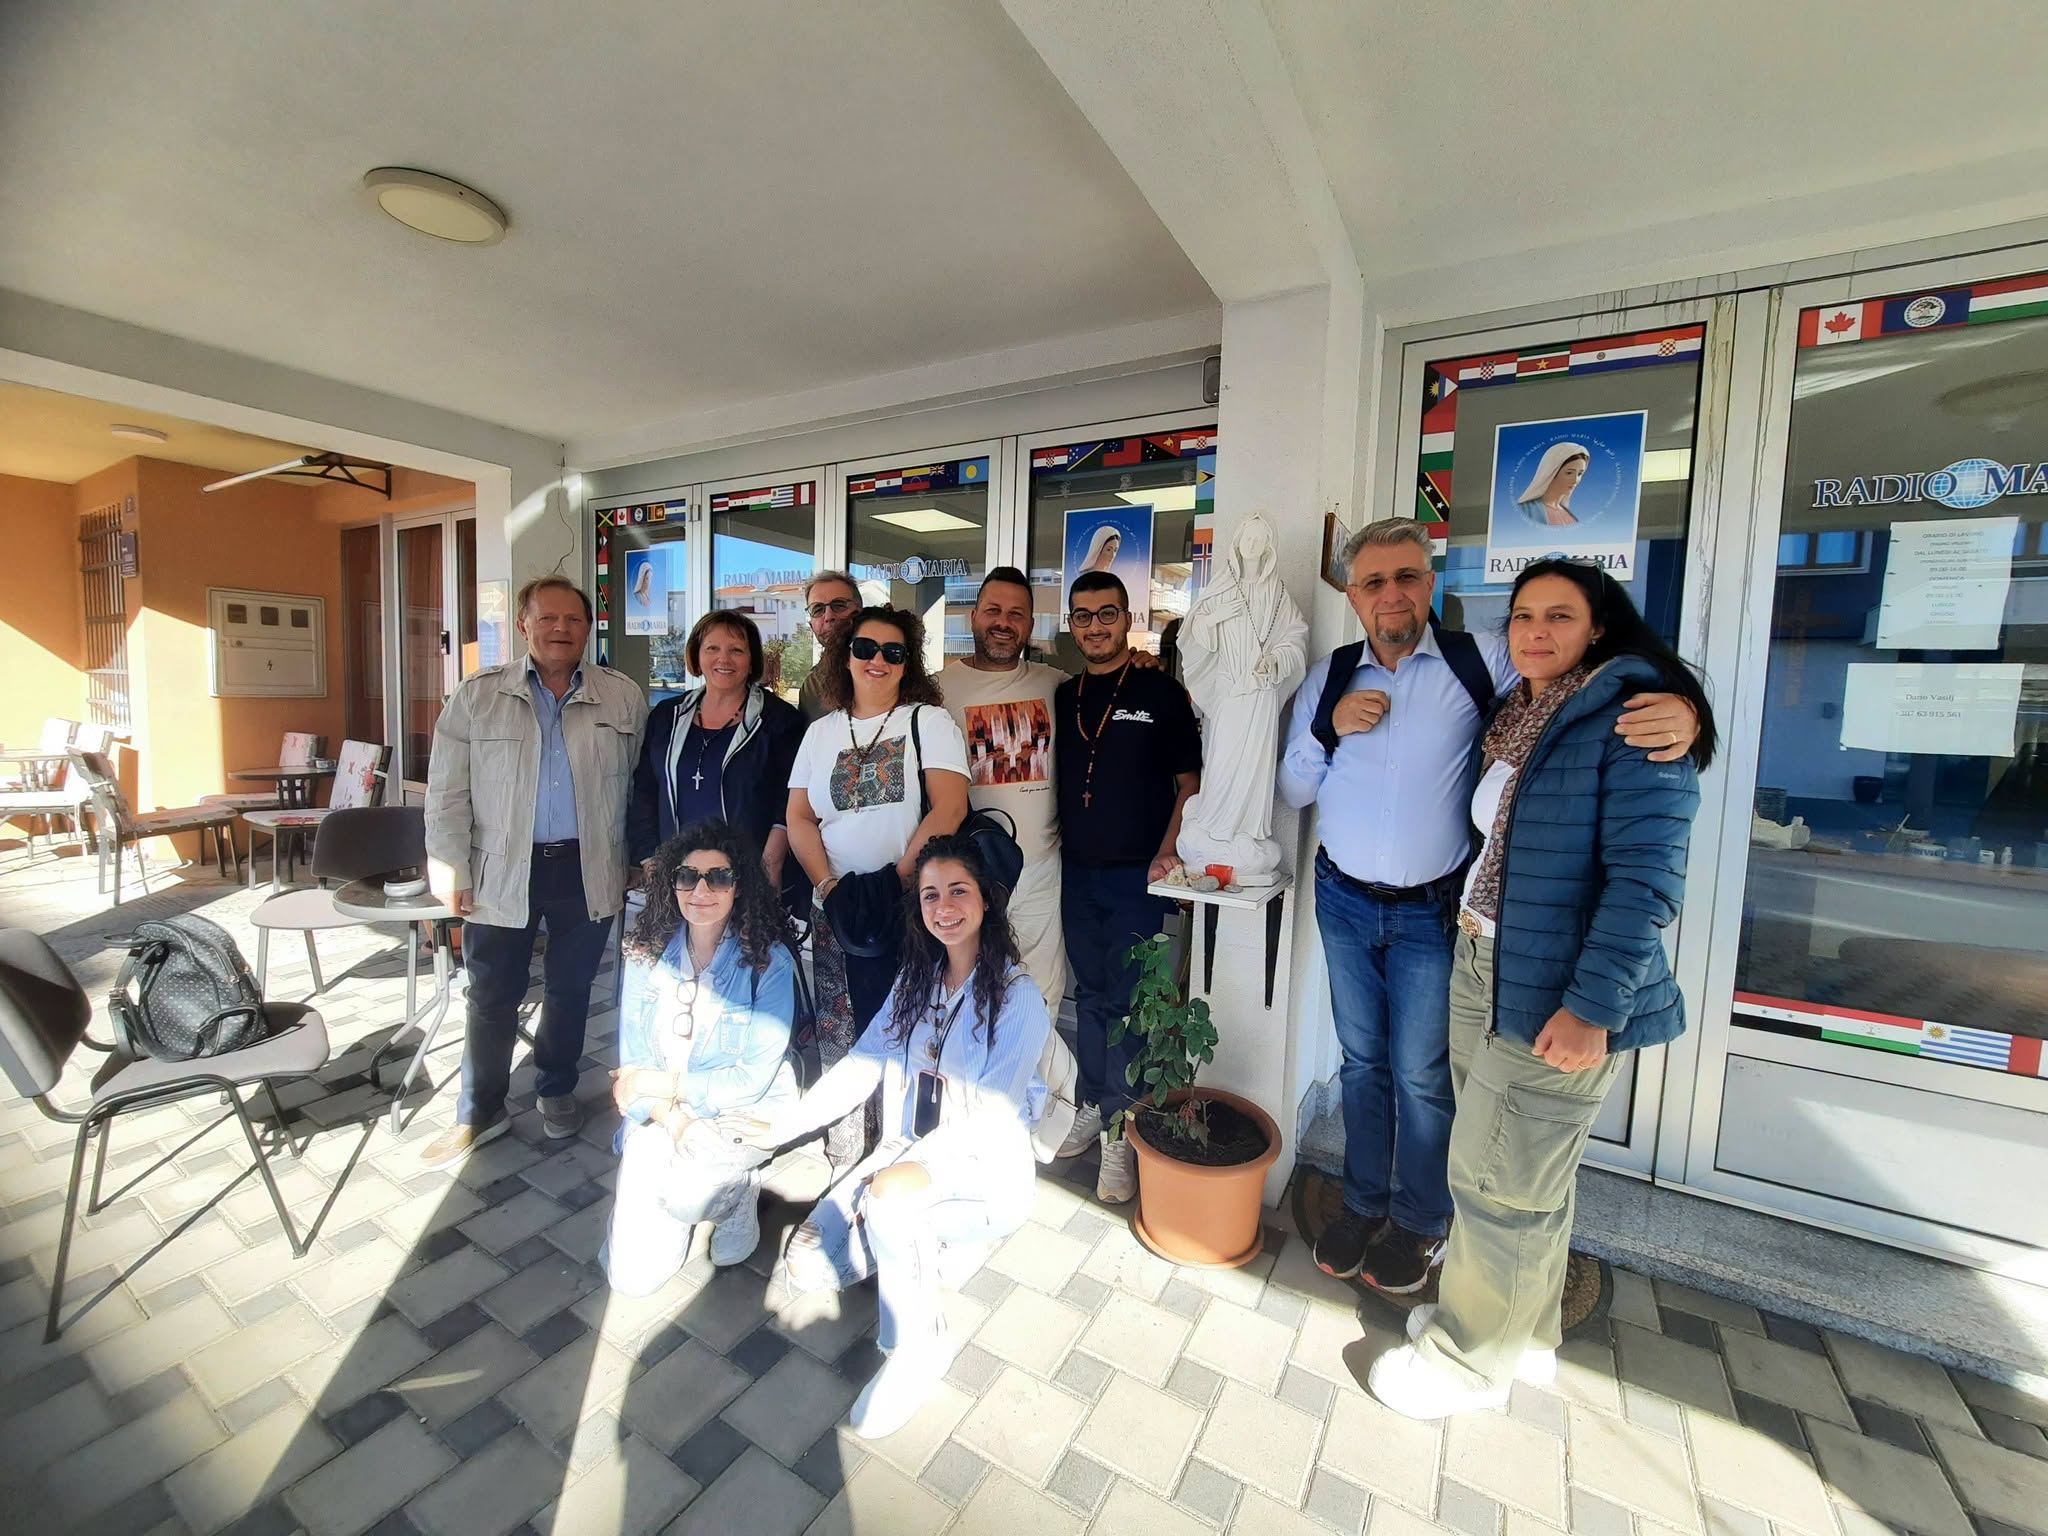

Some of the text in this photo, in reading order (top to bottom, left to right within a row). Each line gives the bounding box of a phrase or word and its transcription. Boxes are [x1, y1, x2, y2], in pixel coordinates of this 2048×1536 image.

[1812, 471, 1957, 508] RADIO
[723, 569, 803, 587] RADIO MARIA
[865, 559, 967, 580] RADIO MARIA
